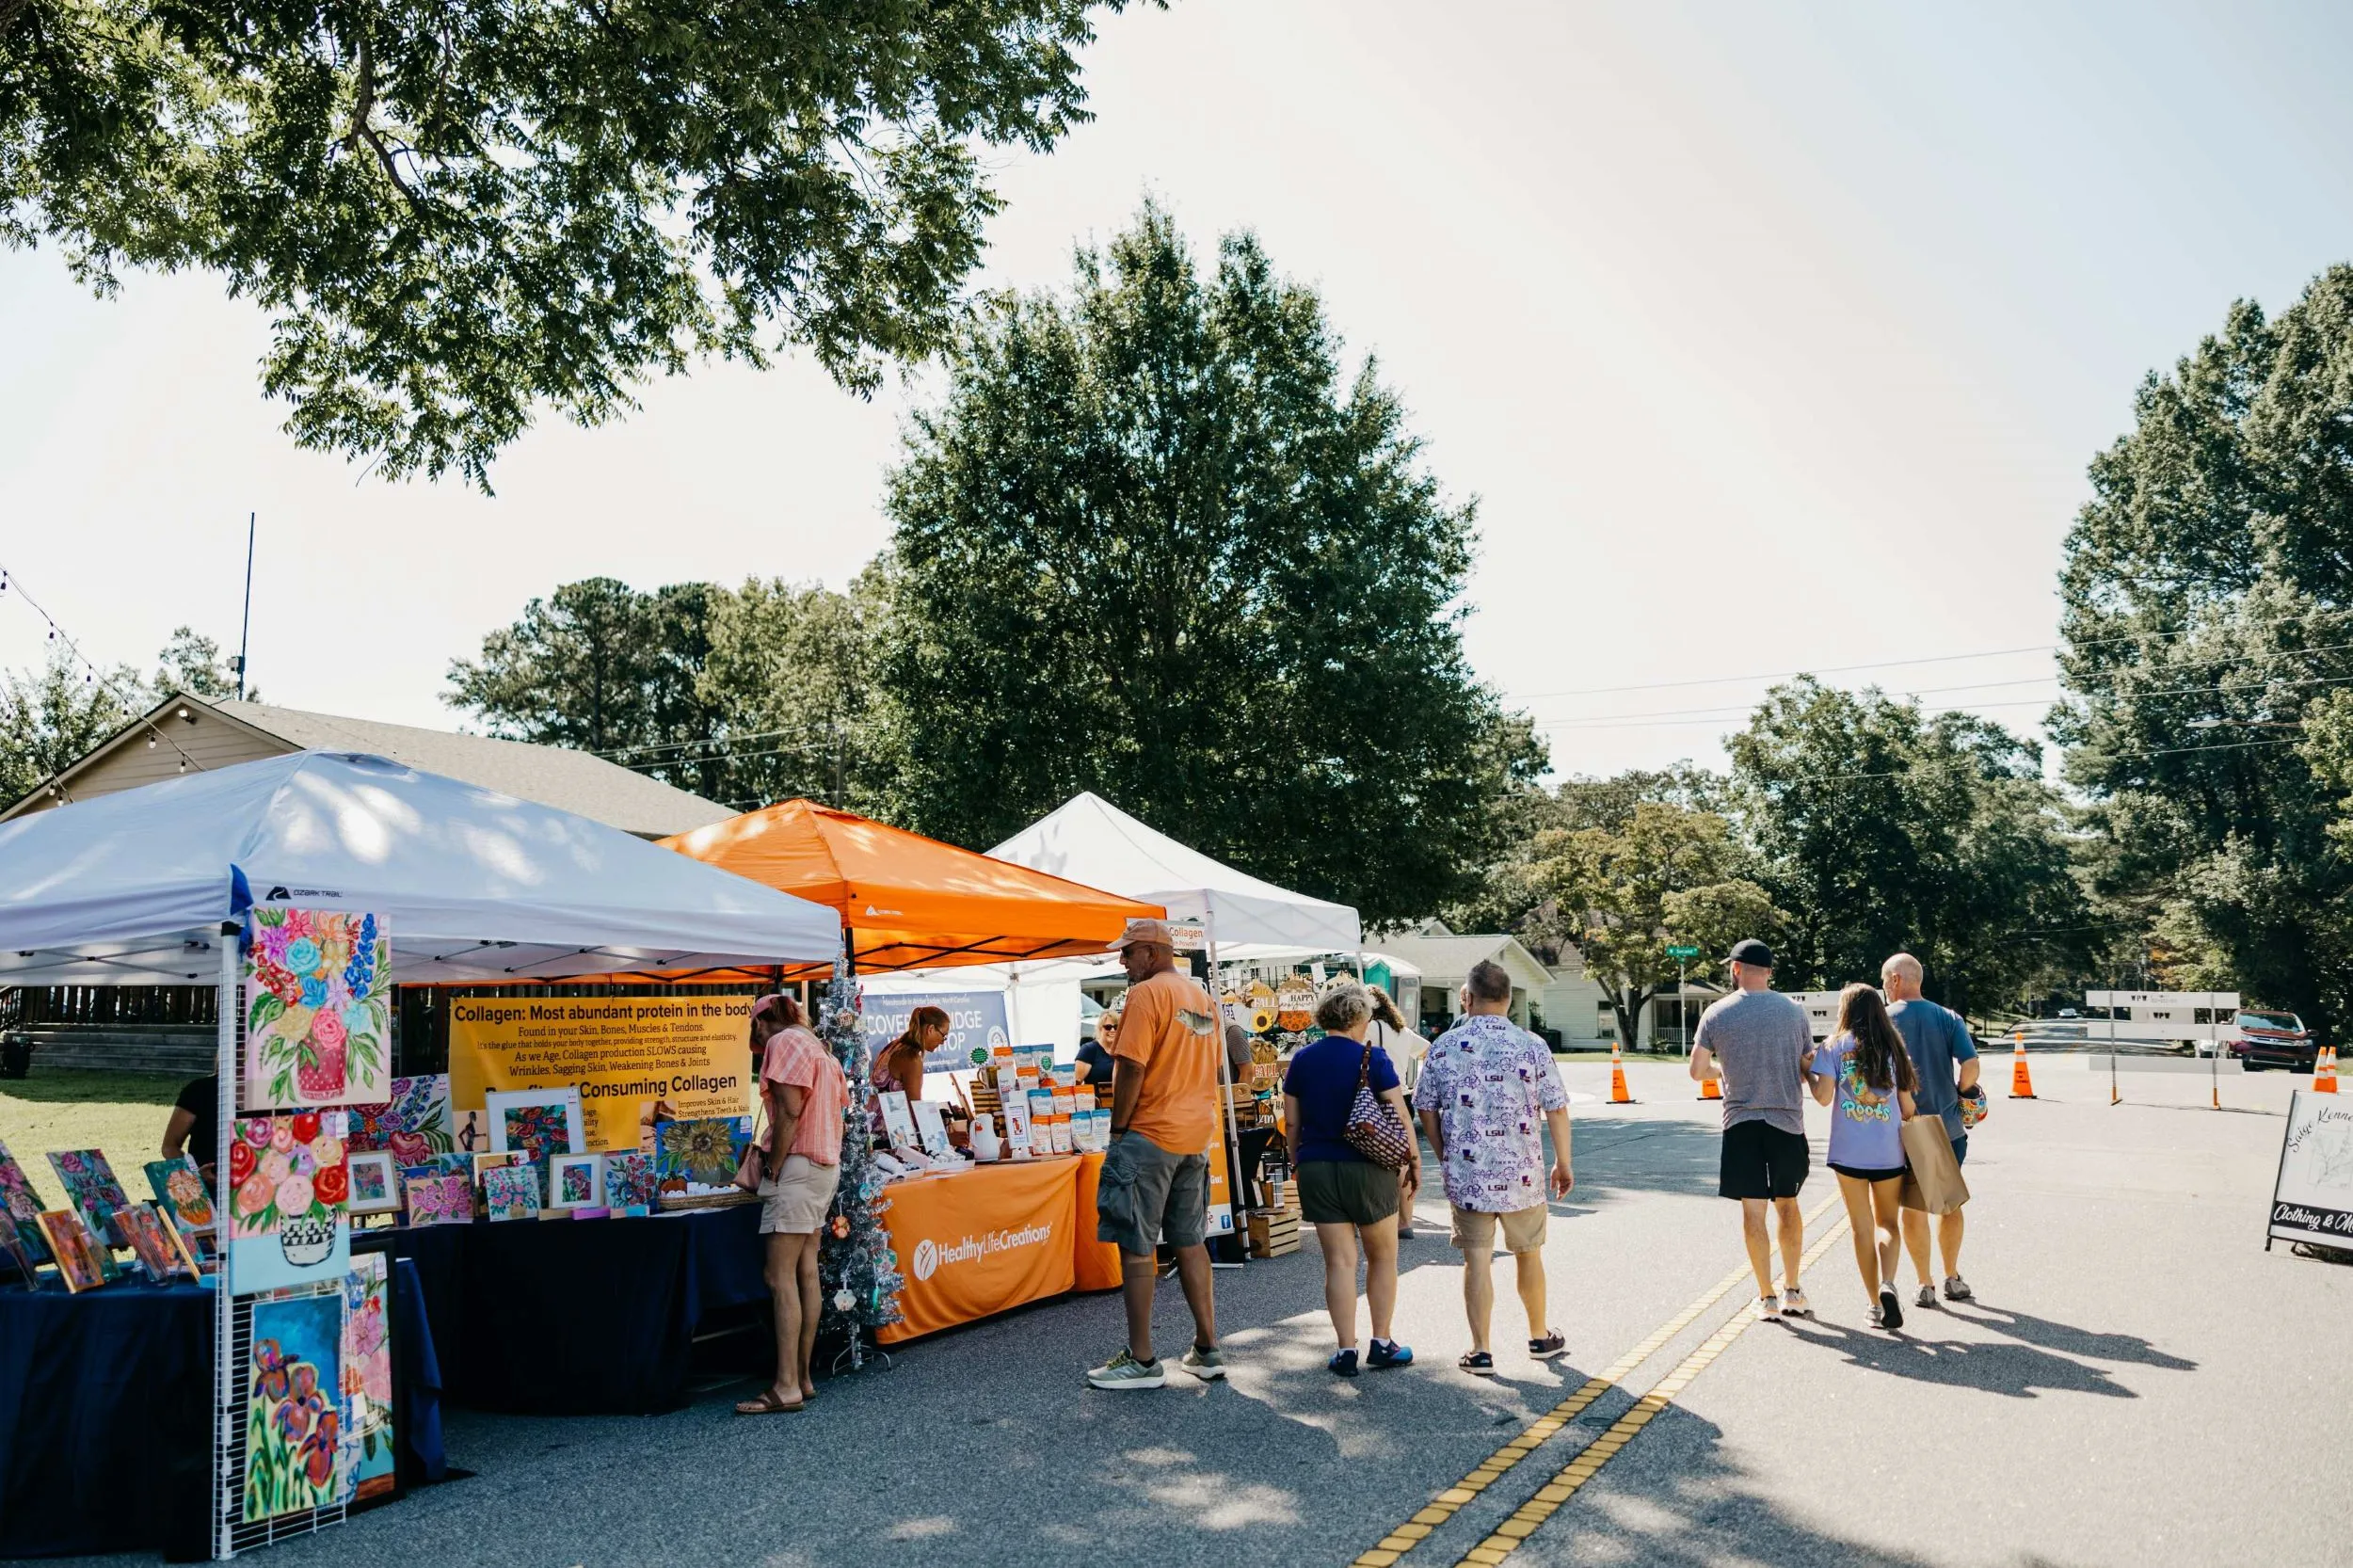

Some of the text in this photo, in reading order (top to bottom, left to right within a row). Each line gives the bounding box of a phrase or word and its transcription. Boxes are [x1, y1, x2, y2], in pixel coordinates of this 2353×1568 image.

[1170, 927, 1203, 939] Collagen
[455, 1003, 753, 1025] Collagen: Most abundant protein in the body
[949, 1011, 983, 1030] IDGE
[519, 1023, 704, 1038] Found in your Skin, Bones, Muscles & Tendons.
[488, 1041, 500, 1049] the
[501, 1041, 517, 1050] glue
[518, 1040, 532, 1048] that
[534, 1039, 552, 1048] holds
[553, 1040, 568, 1048] your
[569, 1038, 584, 1048] body
[613, 1036, 643, 1045] providing
[515, 1052, 526, 1062] As
[563, 1050, 598, 1061] Collagen
[600, 1046, 645, 1060] production
[646, 1046, 676, 1055] SLOWS
[678, 1045, 707, 1055] causing
[509, 1065, 551, 1076] Wrinkles,
[553, 1064, 585, 1076] Sagging
[587, 1063, 608, 1072] Skin,
[609, 1060, 654, 1071] Weakening
[655, 1059, 679, 1069] Bones
[688, 1058, 710, 1067] Joints
[1253, 1063, 1279, 1077] FALL
[580, 1078, 667, 1098] Consuming
[672, 1075, 736, 1093] Collagen
[678, 1101, 706, 1109] Improves
[1841, 1099, 1891, 1122] Roots
[678, 1109, 716, 1119] Strengthens
[2287, 1121, 2312, 1153] Saige
[2273, 1204, 2321, 1231] Clothing
[2323, 1214, 2334, 1227] &
